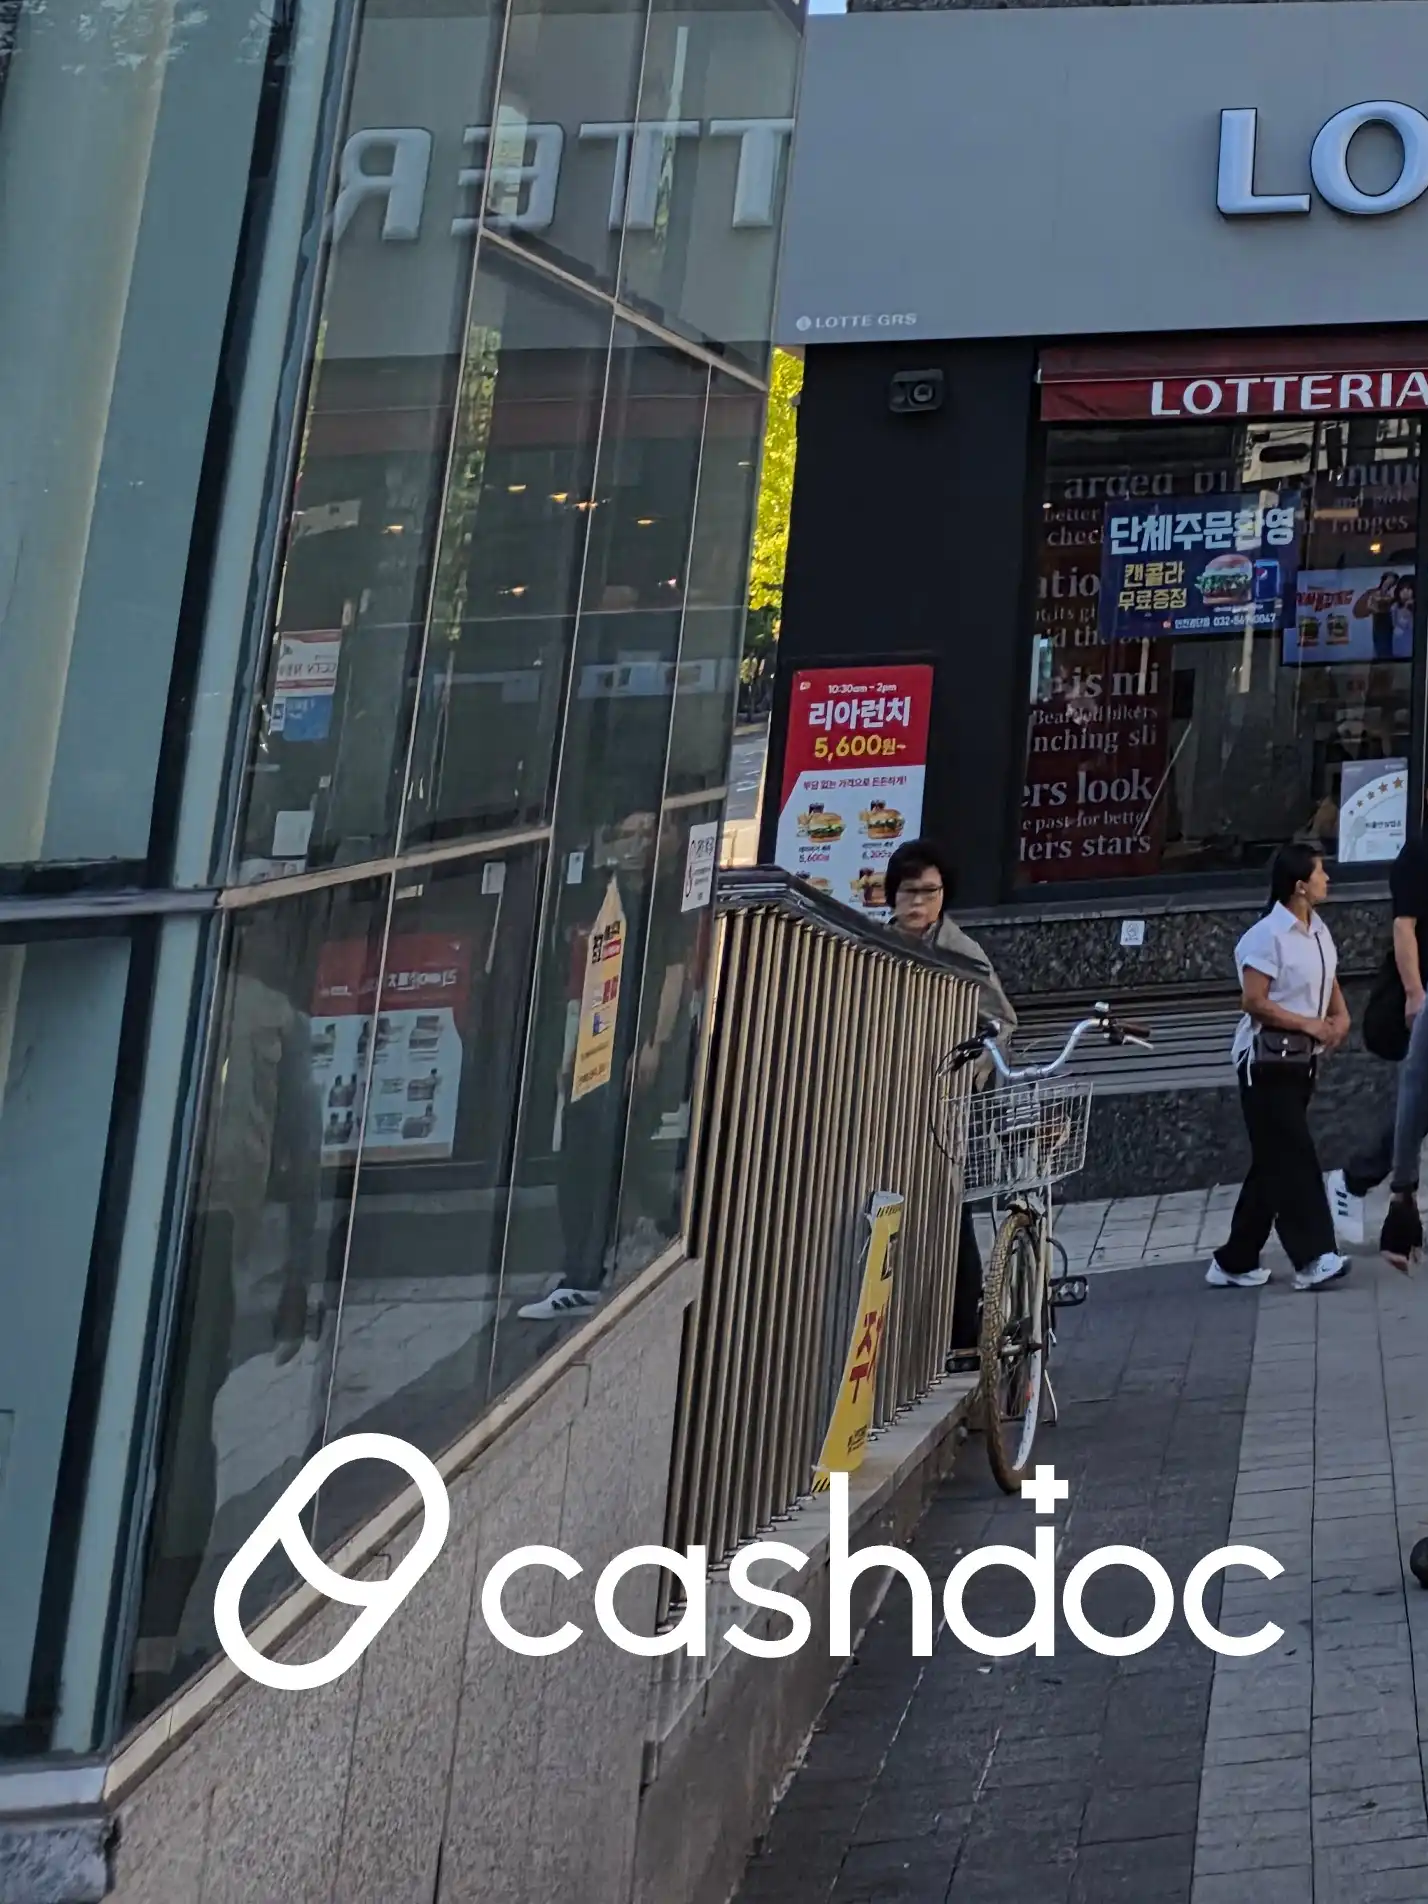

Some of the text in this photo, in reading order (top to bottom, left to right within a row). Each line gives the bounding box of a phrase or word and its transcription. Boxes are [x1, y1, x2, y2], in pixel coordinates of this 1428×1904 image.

[815, 312, 918, 331] LOTTE GRS
[1109, 507, 1295, 555] 단체주문환영
[1122, 560, 1185, 588] 캔콜라
[1117, 588, 1188, 612] 무료증정
[876, 681, 897, 693] 2pm
[808, 696, 912, 731] 리아런치
[1076, 767, 1154, 804] look
[1080, 830, 1153, 857] stars
